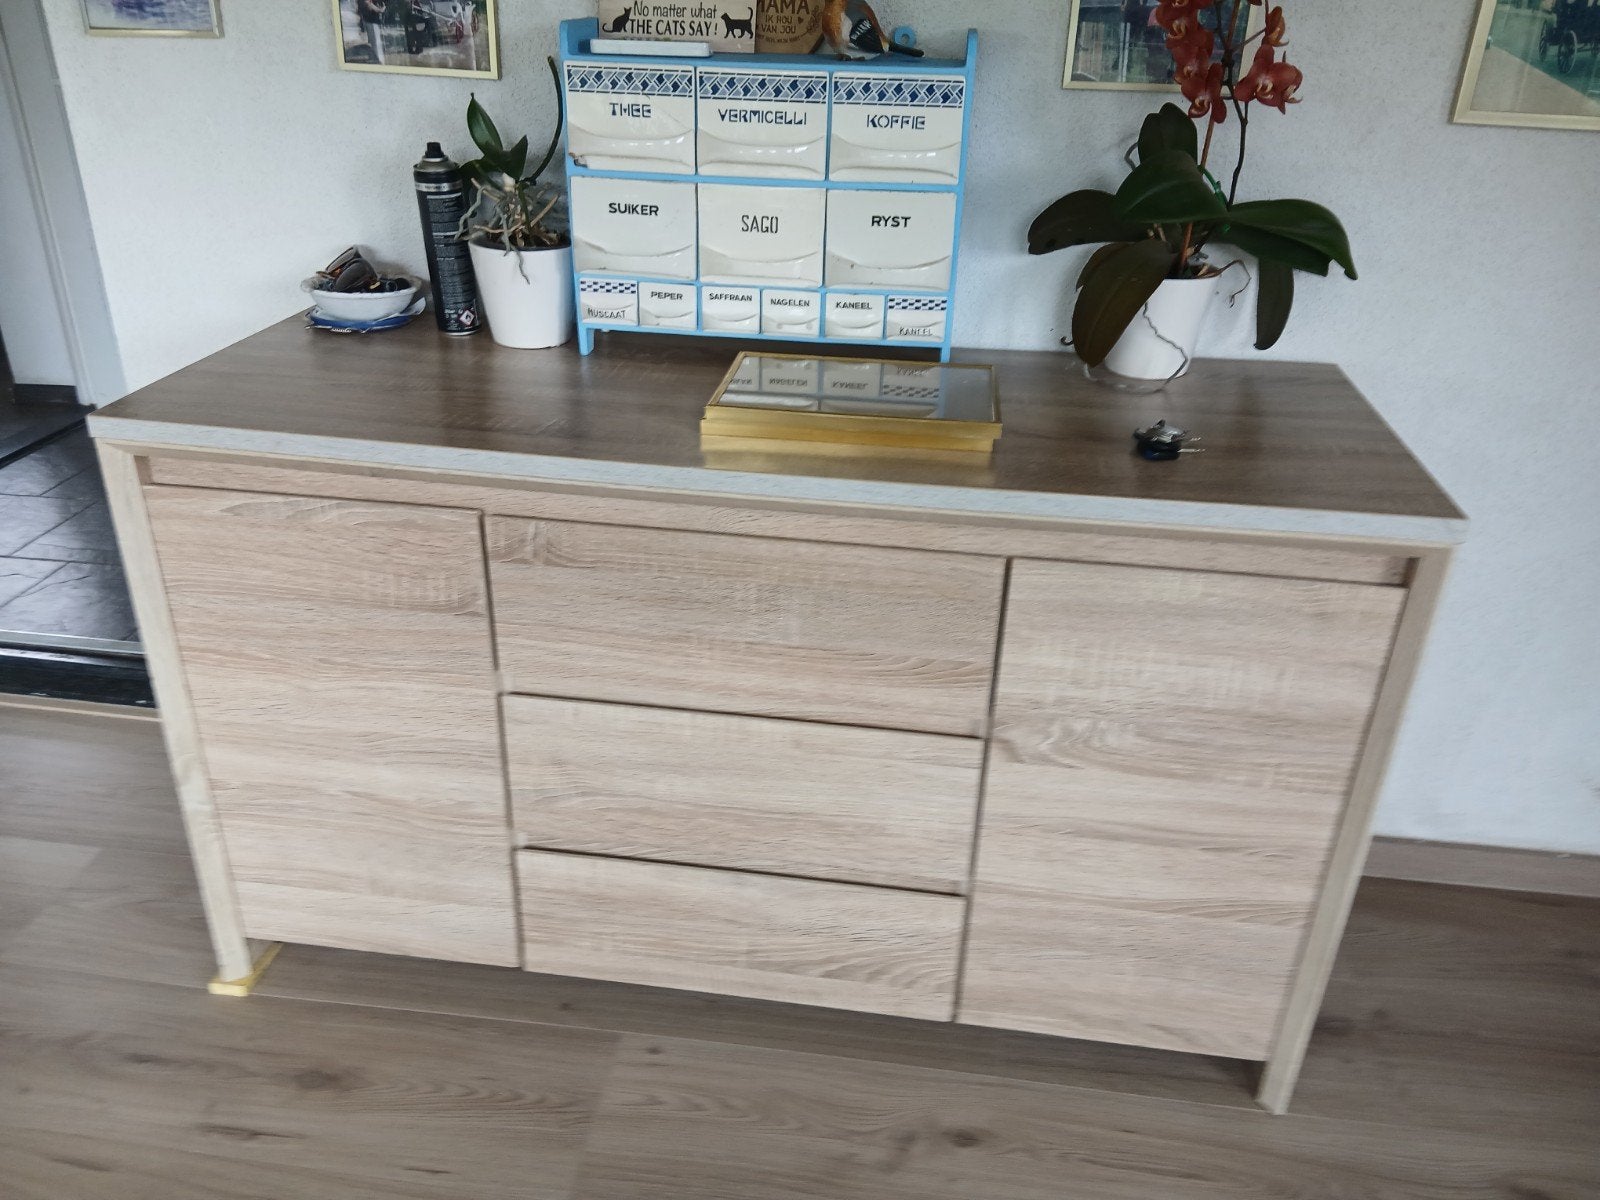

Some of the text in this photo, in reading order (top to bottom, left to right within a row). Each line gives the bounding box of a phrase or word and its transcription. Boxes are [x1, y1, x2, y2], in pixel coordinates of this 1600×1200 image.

[633, 0, 717, 19] No matter what
[765, 14, 793, 25] IK HOU
[629, 19, 652, 35] THE
[655, 20, 686, 36] CATS
[761, 24, 797, 34] VAN JOU
[609, 102, 652, 119] THEE
[717, 108, 808, 126] VERMICELLI
[866, 114, 926, 131] KOFFIE
[608, 202, 660, 217] SUIKER
[740, 214, 780, 235] SAGO
[870, 214, 912, 229] RYST
[650, 291, 684, 301] PEPER
[708, 292, 754, 302] SAFFRAAN
[770, 298, 811, 308] NAGELEN
[835, 301, 873, 311] KANEEL
